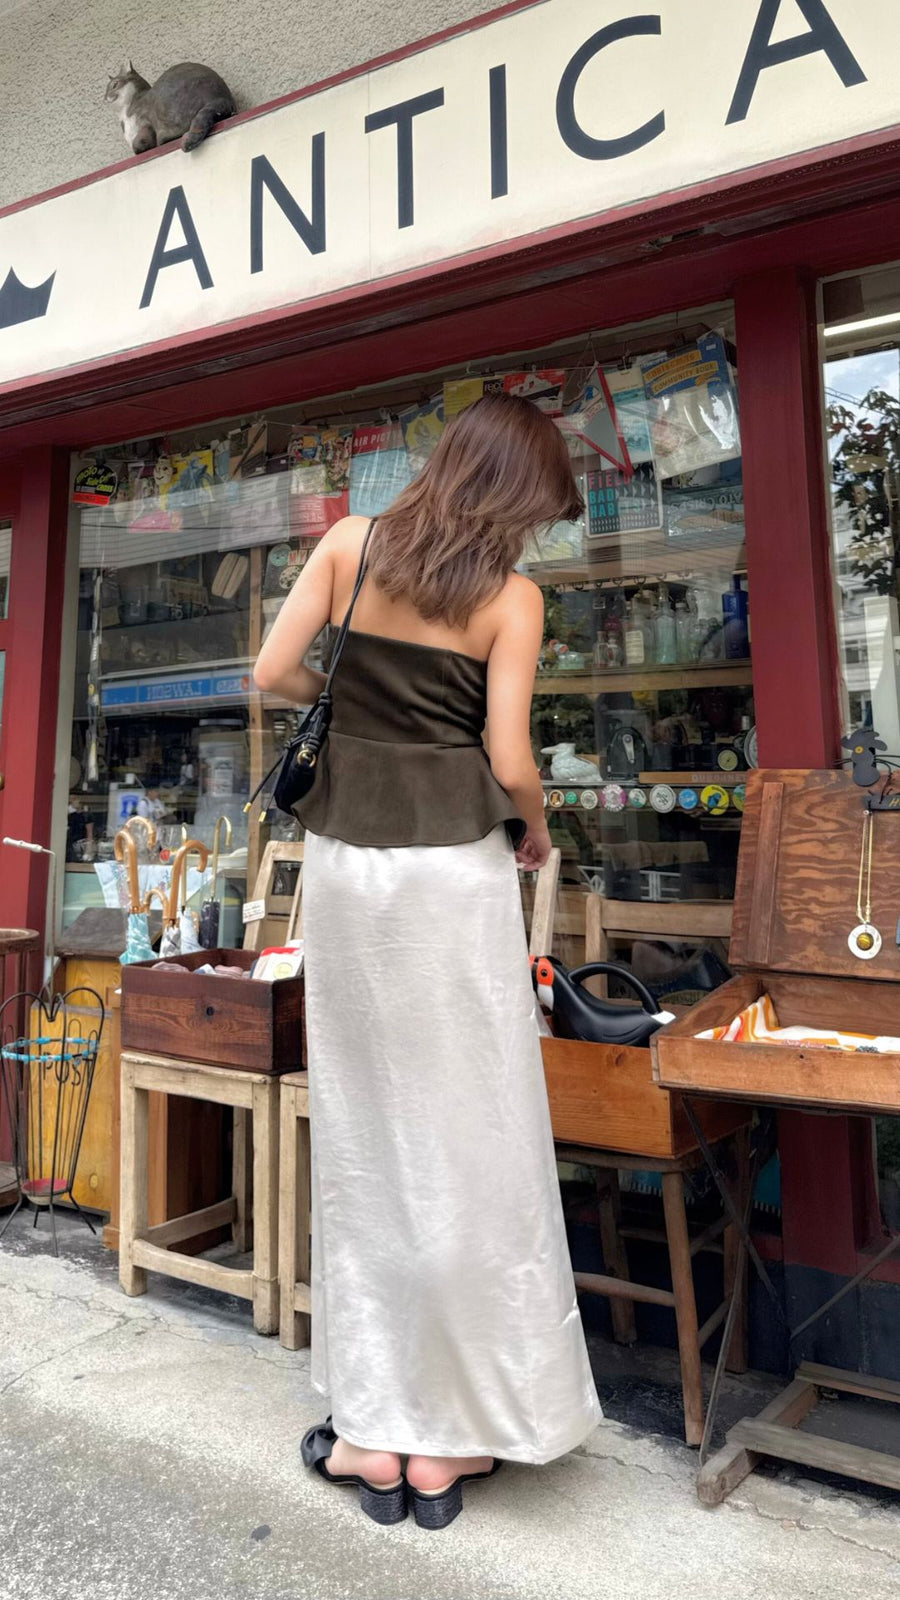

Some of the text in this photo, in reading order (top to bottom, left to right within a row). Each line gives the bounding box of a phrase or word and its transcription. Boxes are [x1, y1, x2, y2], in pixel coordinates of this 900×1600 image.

[139, 0, 869, 309] ANTICA
[353, 436, 368, 448] AIR
[588, 487, 614, 505] BAD
